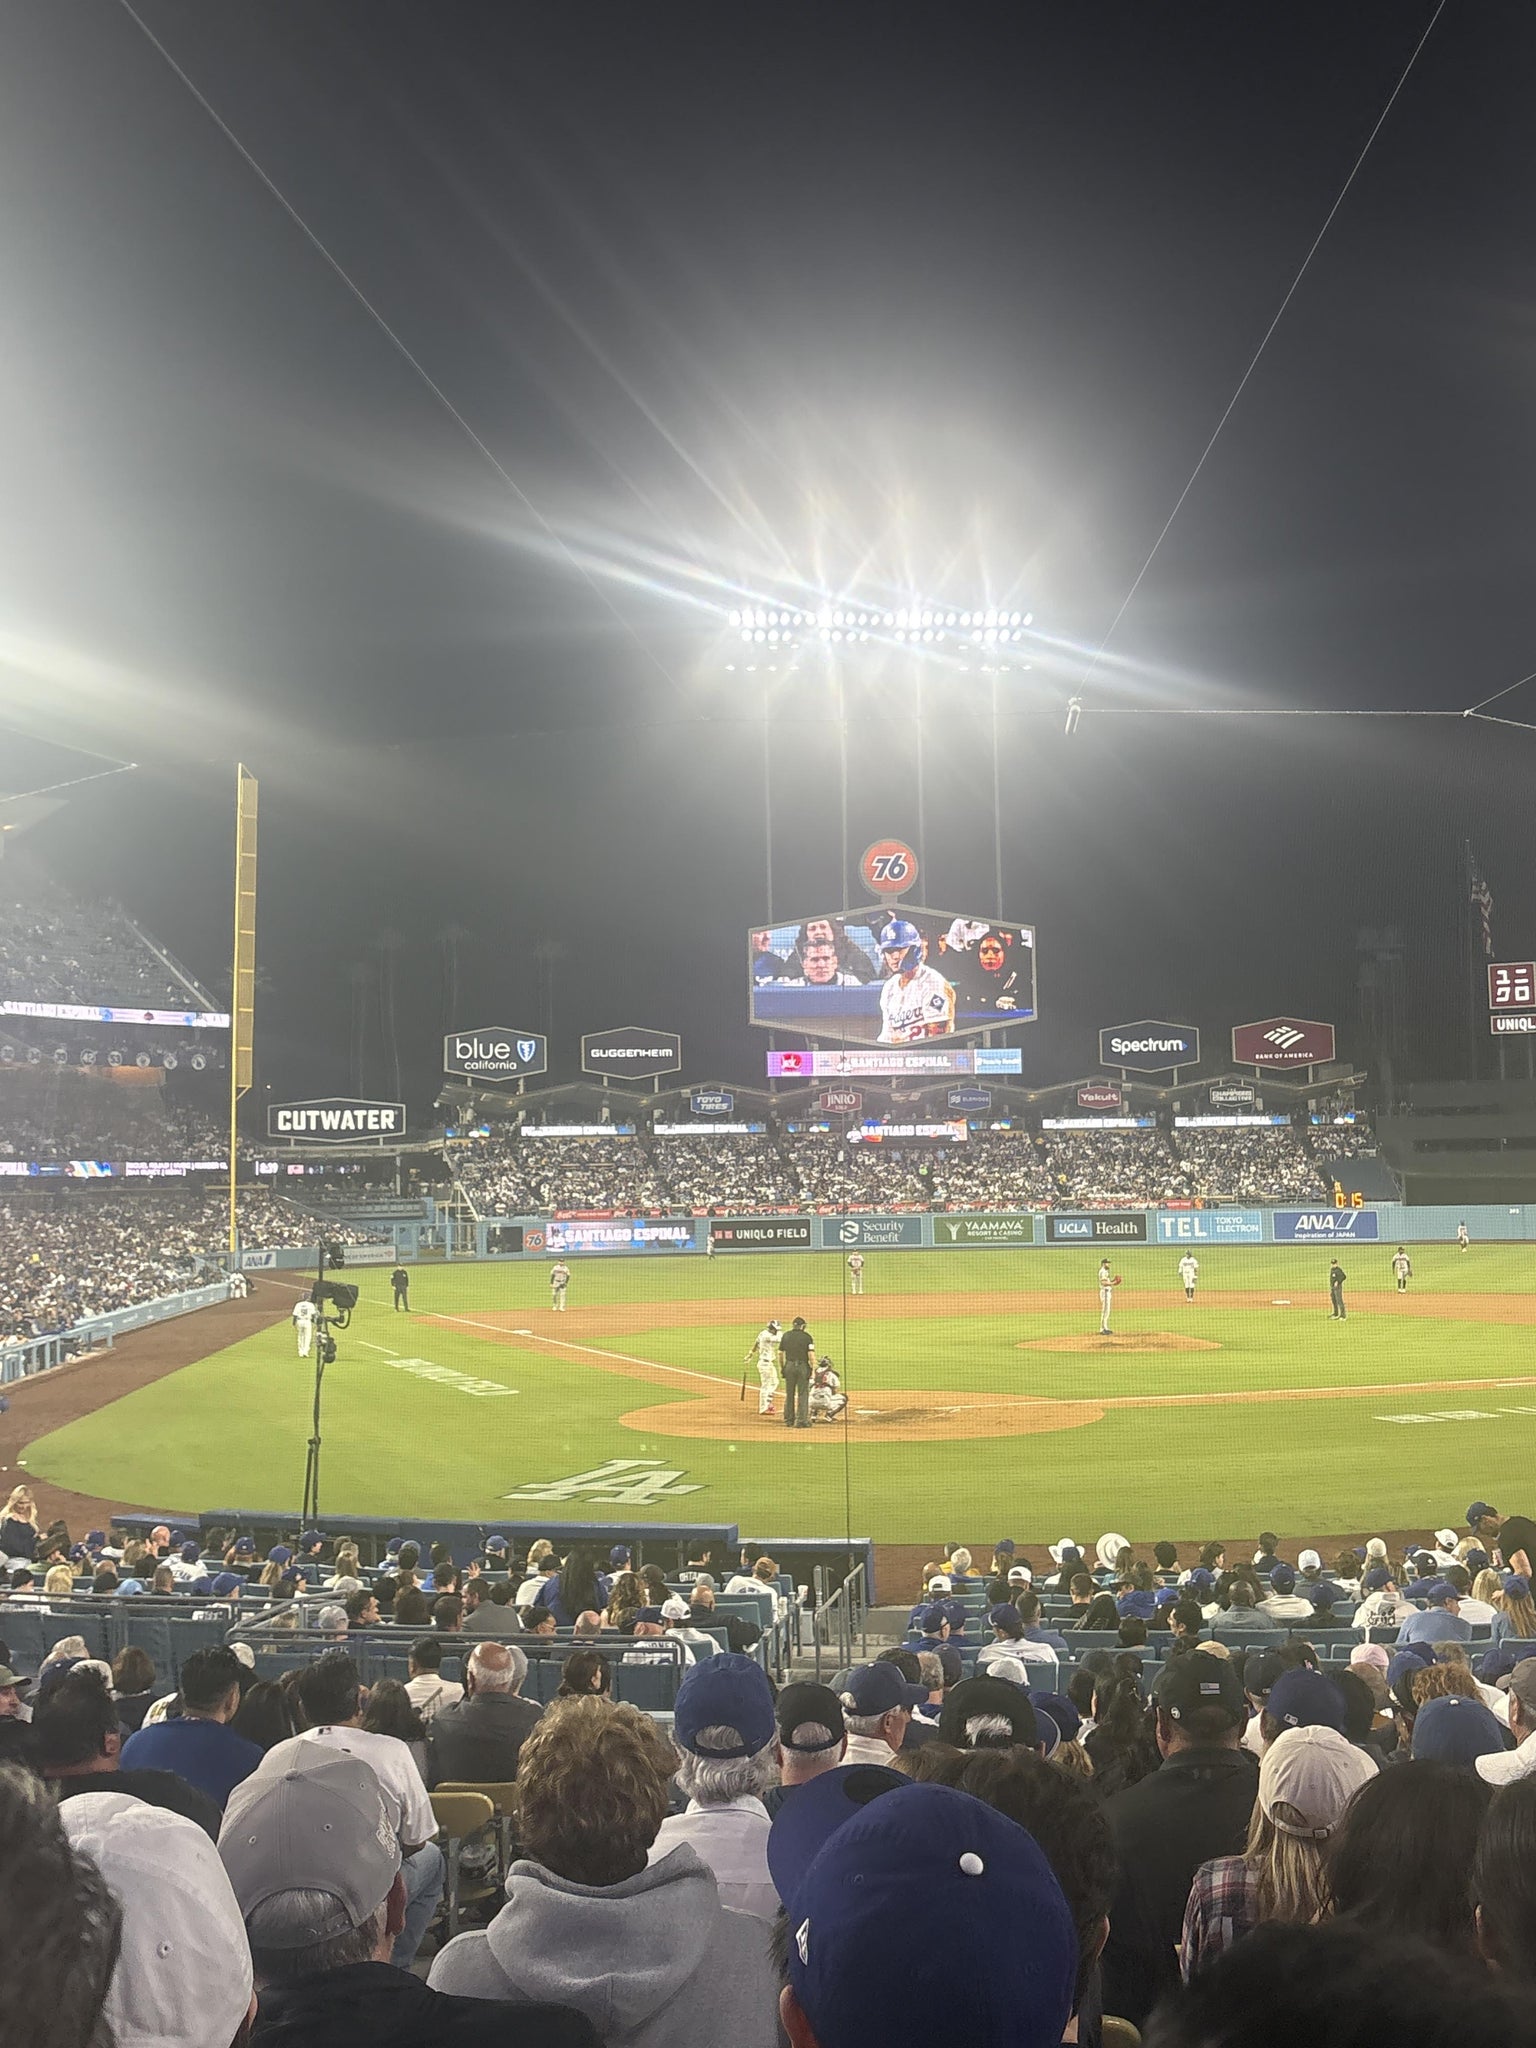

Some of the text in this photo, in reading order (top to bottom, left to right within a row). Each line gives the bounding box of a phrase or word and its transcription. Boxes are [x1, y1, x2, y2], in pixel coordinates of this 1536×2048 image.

[872, 853, 906, 881] 76
[455, 1037, 511, 1060] blue
[1111, 1038, 1184, 1055] Spectrum
[590, 1047, 673, 1059] GUGGENHEIM
[464, 1060, 518, 1070] california
[851, 1056, 951, 1068] SANTIAGO ESPINAL
[827, 1094, 856, 1108] JINRO
[1080, 1093, 1119, 1102] Yakult
[700, 1102, 729, 1110] TIRES
[277, 1108, 396, 1131] CUTWATER
[860, 1125, 914, 1137] SANTIAGO
[1335, 1192, 1364, 1209] 0:15
[863, 1221, 904, 1233] Security
[1215, 1217, 1243, 1225] TOKYO
[1294, 1214, 1335, 1230] ANA
[998, 1229, 1023, 1237] CASINO
[1059, 1221, 1138, 1234] UCLA Health
[1161, 1217, 1208, 1238] TEL
[1216, 1225, 1260, 1233] ELECTRON
[526, 1235, 543, 1245] 76
[565, 1226, 690, 1243] SANTIAGO ESPINAL
[736, 1228, 808, 1240] UNIQLO FIELD
[863, 1232, 900, 1243] Benefit
[244, 1253, 264, 1267] ANA
[497, 1459, 710, 1506] LA
